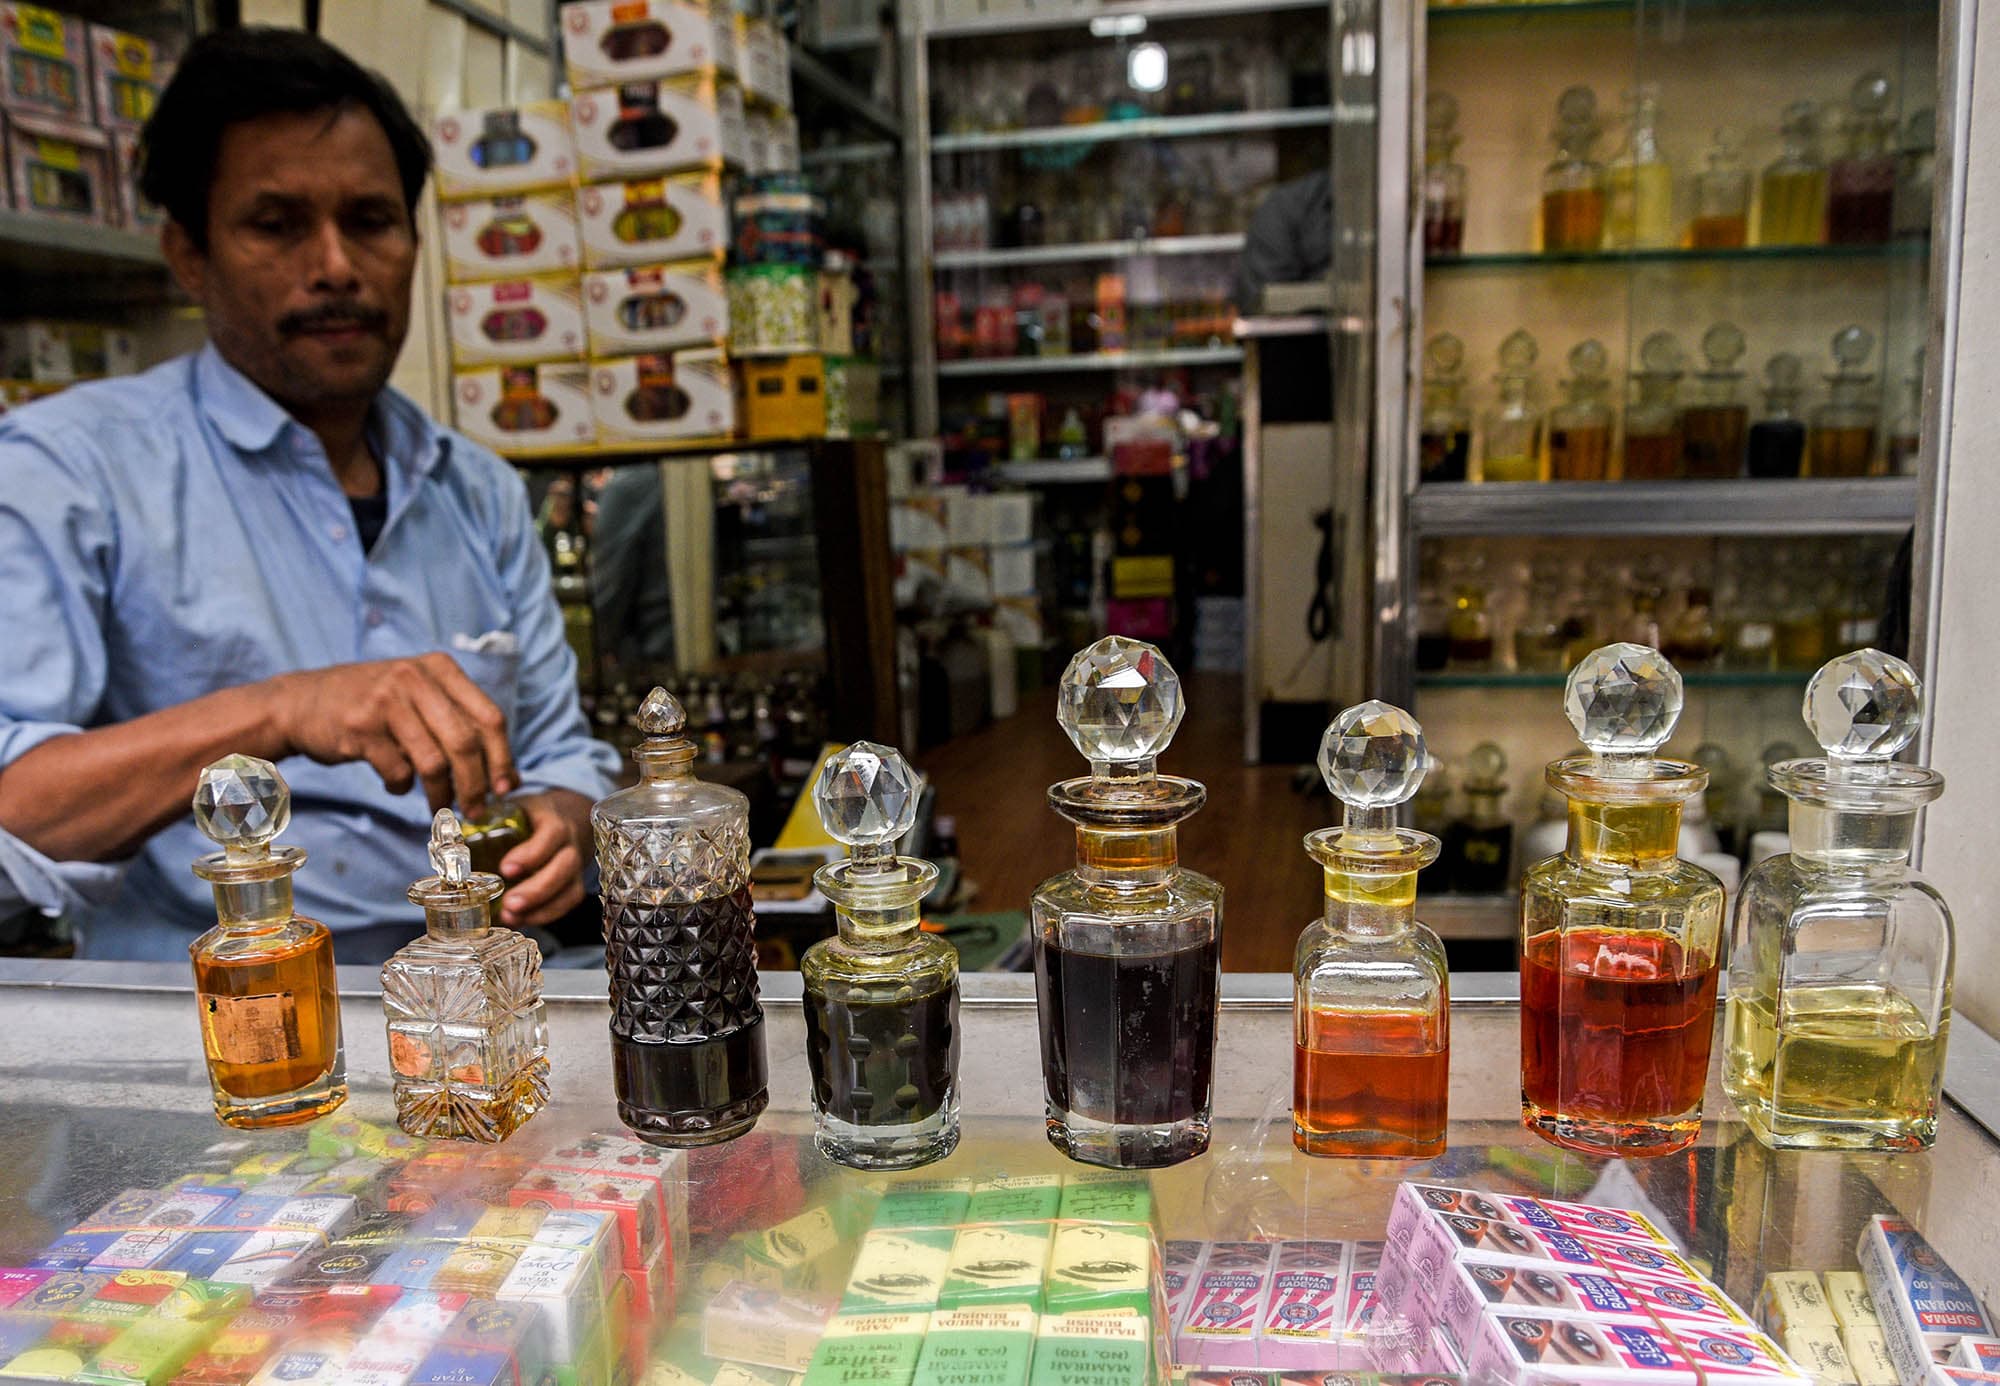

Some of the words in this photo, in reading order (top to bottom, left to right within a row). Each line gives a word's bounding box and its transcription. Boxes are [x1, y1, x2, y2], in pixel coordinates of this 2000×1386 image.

[1204, 1281, 1257, 1289] BADEYANI
[1281, 1276, 1329, 1284] SURMA
[1912, 1280, 1935, 1290] 100
[1278, 1281, 1331, 1290] BADEYANI
[1580, 1275, 1609, 1305] SURMA
[1593, 1274, 1628, 1311] BADEYANI
[1913, 1299, 1975, 1313] NOORANI
[938, 1319, 983, 1328] KHUDA
[989, 1320, 1020, 1328] HAJI
[1066, 1319, 1123, 1328] BUKHSH
[1921, 1313, 1977, 1326] SURMA
[1052, 1326, 1099, 1336] KHUDA
[1104, 1328, 1137, 1336] HAJI
[1055, 1348, 1088, 1360] 100)
[1051, 1361, 1132, 1374] MAMIRAH
[937, 1374, 1006, 1385] SURMA
[1061, 1375, 1132, 1386] SURMA
